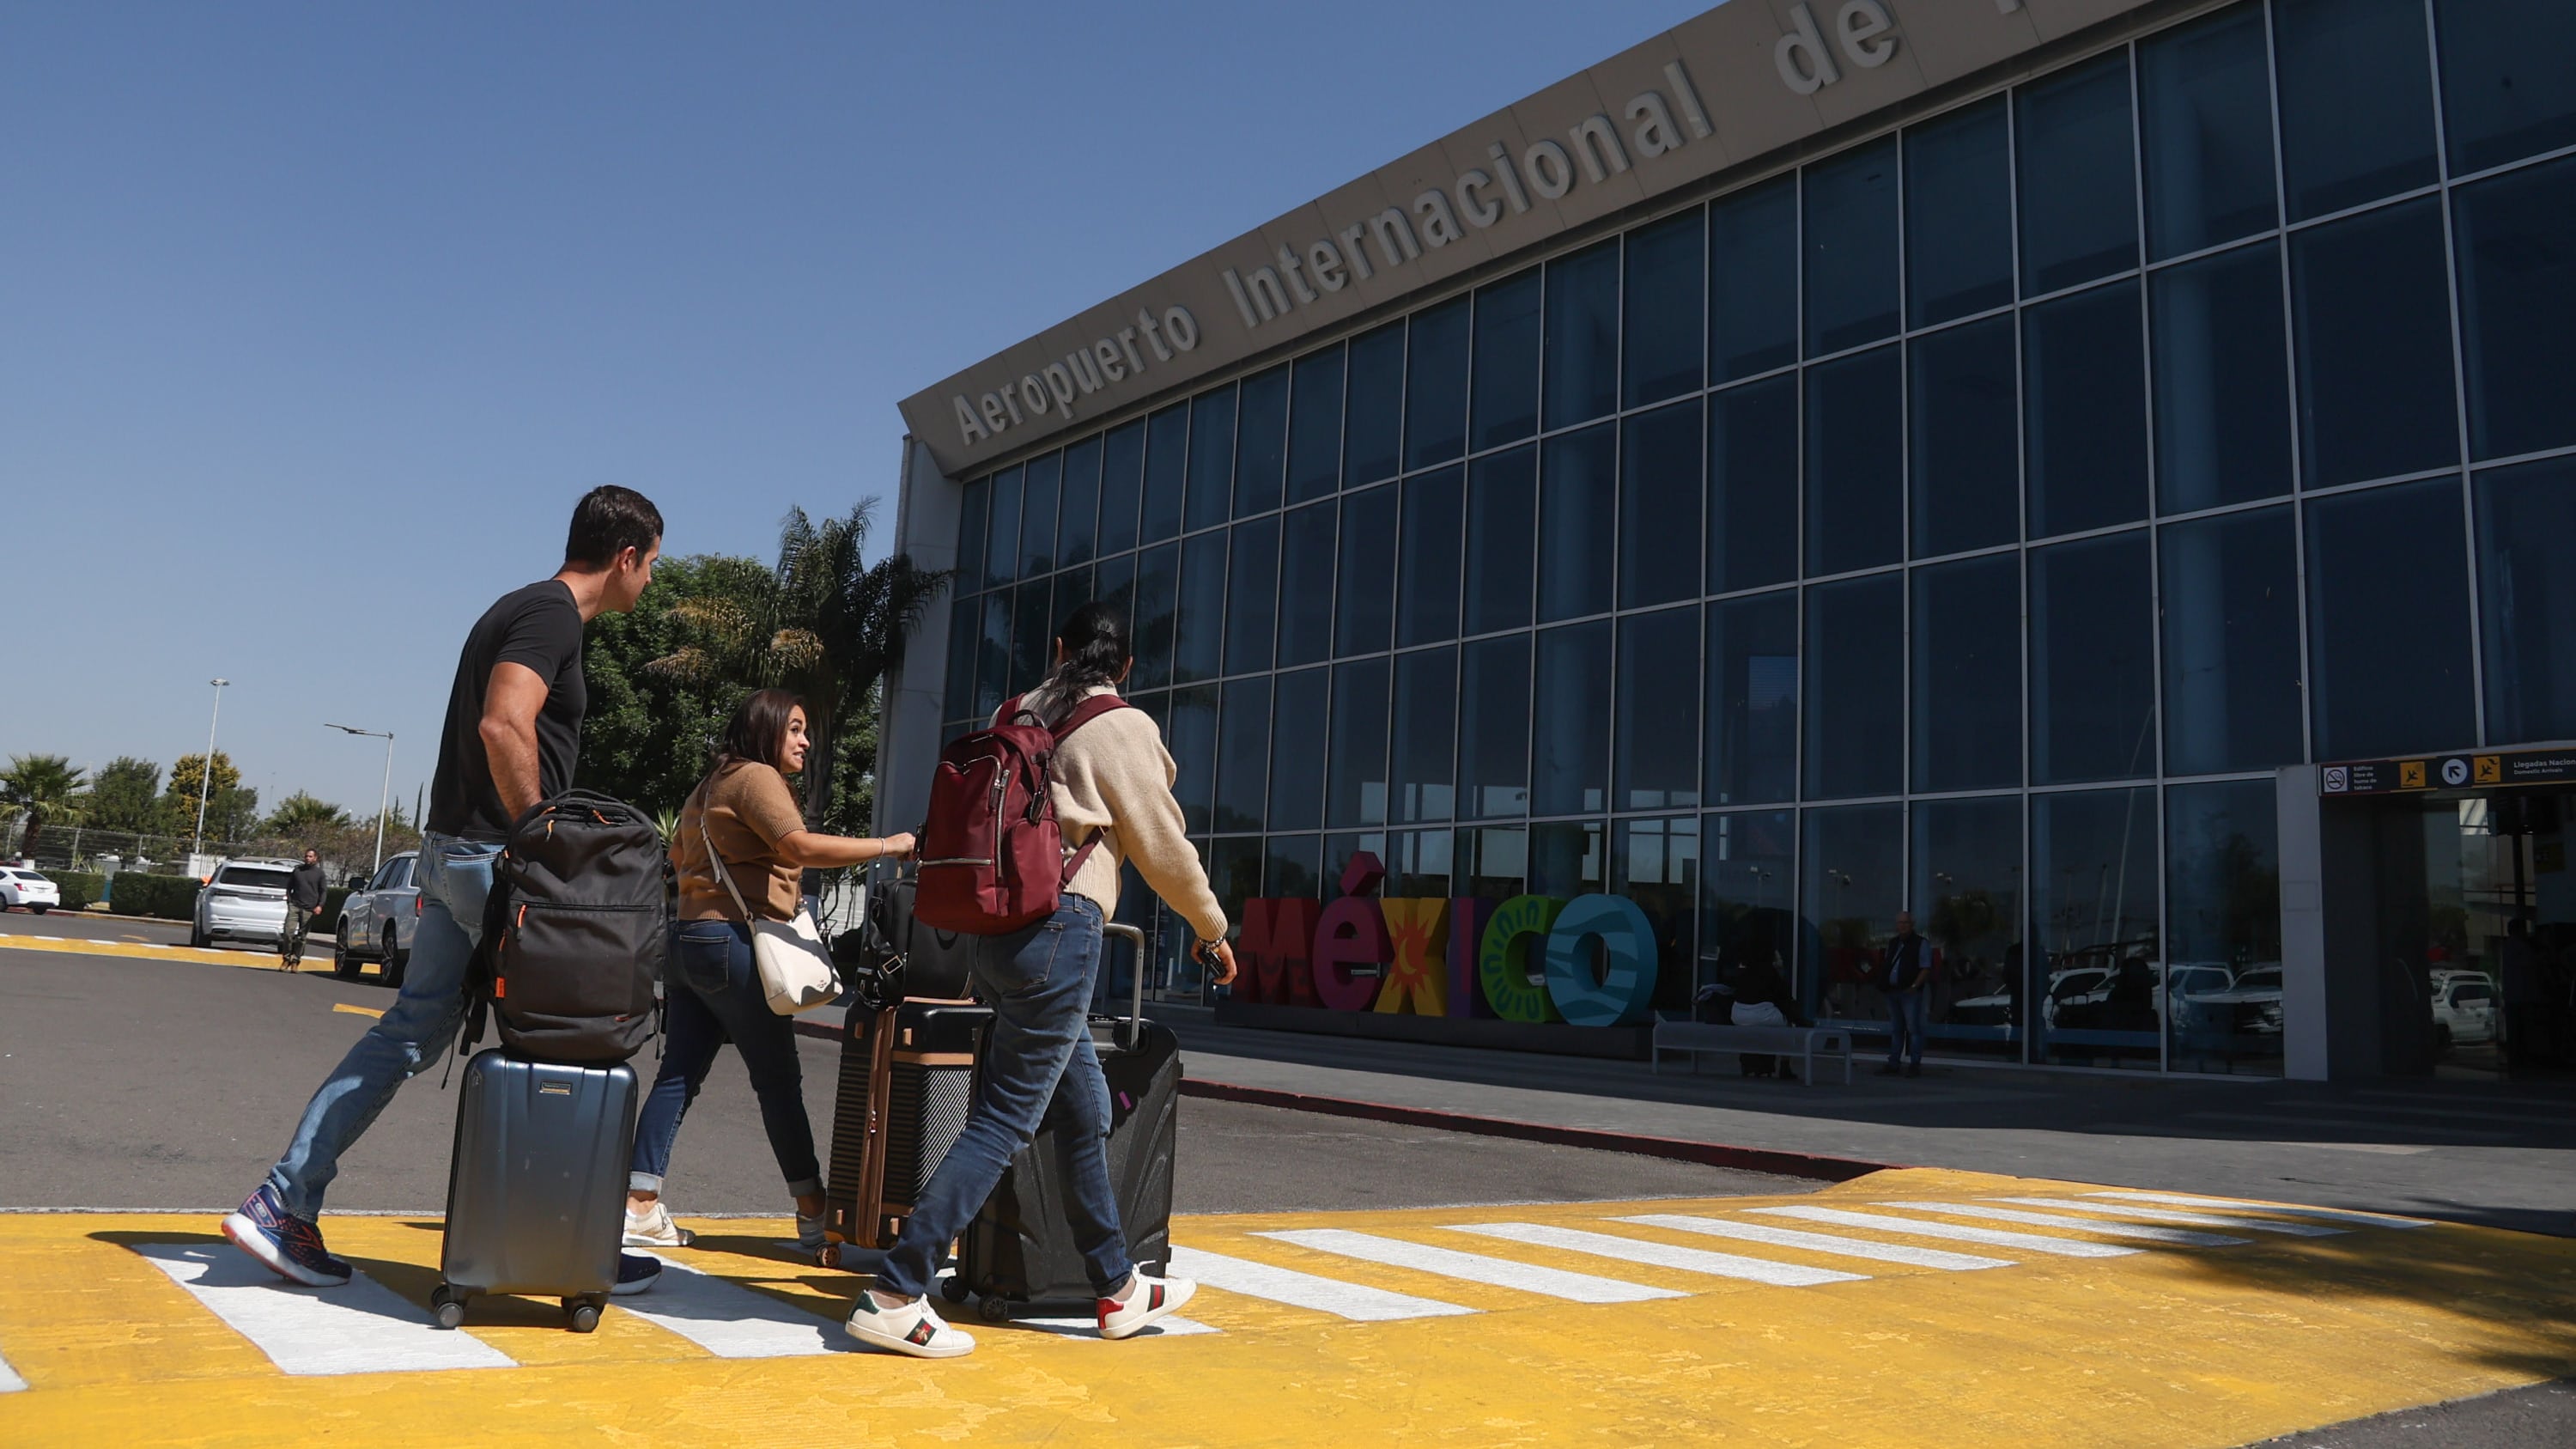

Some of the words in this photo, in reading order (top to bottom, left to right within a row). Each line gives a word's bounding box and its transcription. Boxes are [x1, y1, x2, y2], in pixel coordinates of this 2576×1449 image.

[953, 305, 1200, 446] Aeropuerto
[1223, 58, 1715, 329] Internacional
[1774, 0, 1897, 94] de
[2514, 760, 2548, 769] Llegadas
